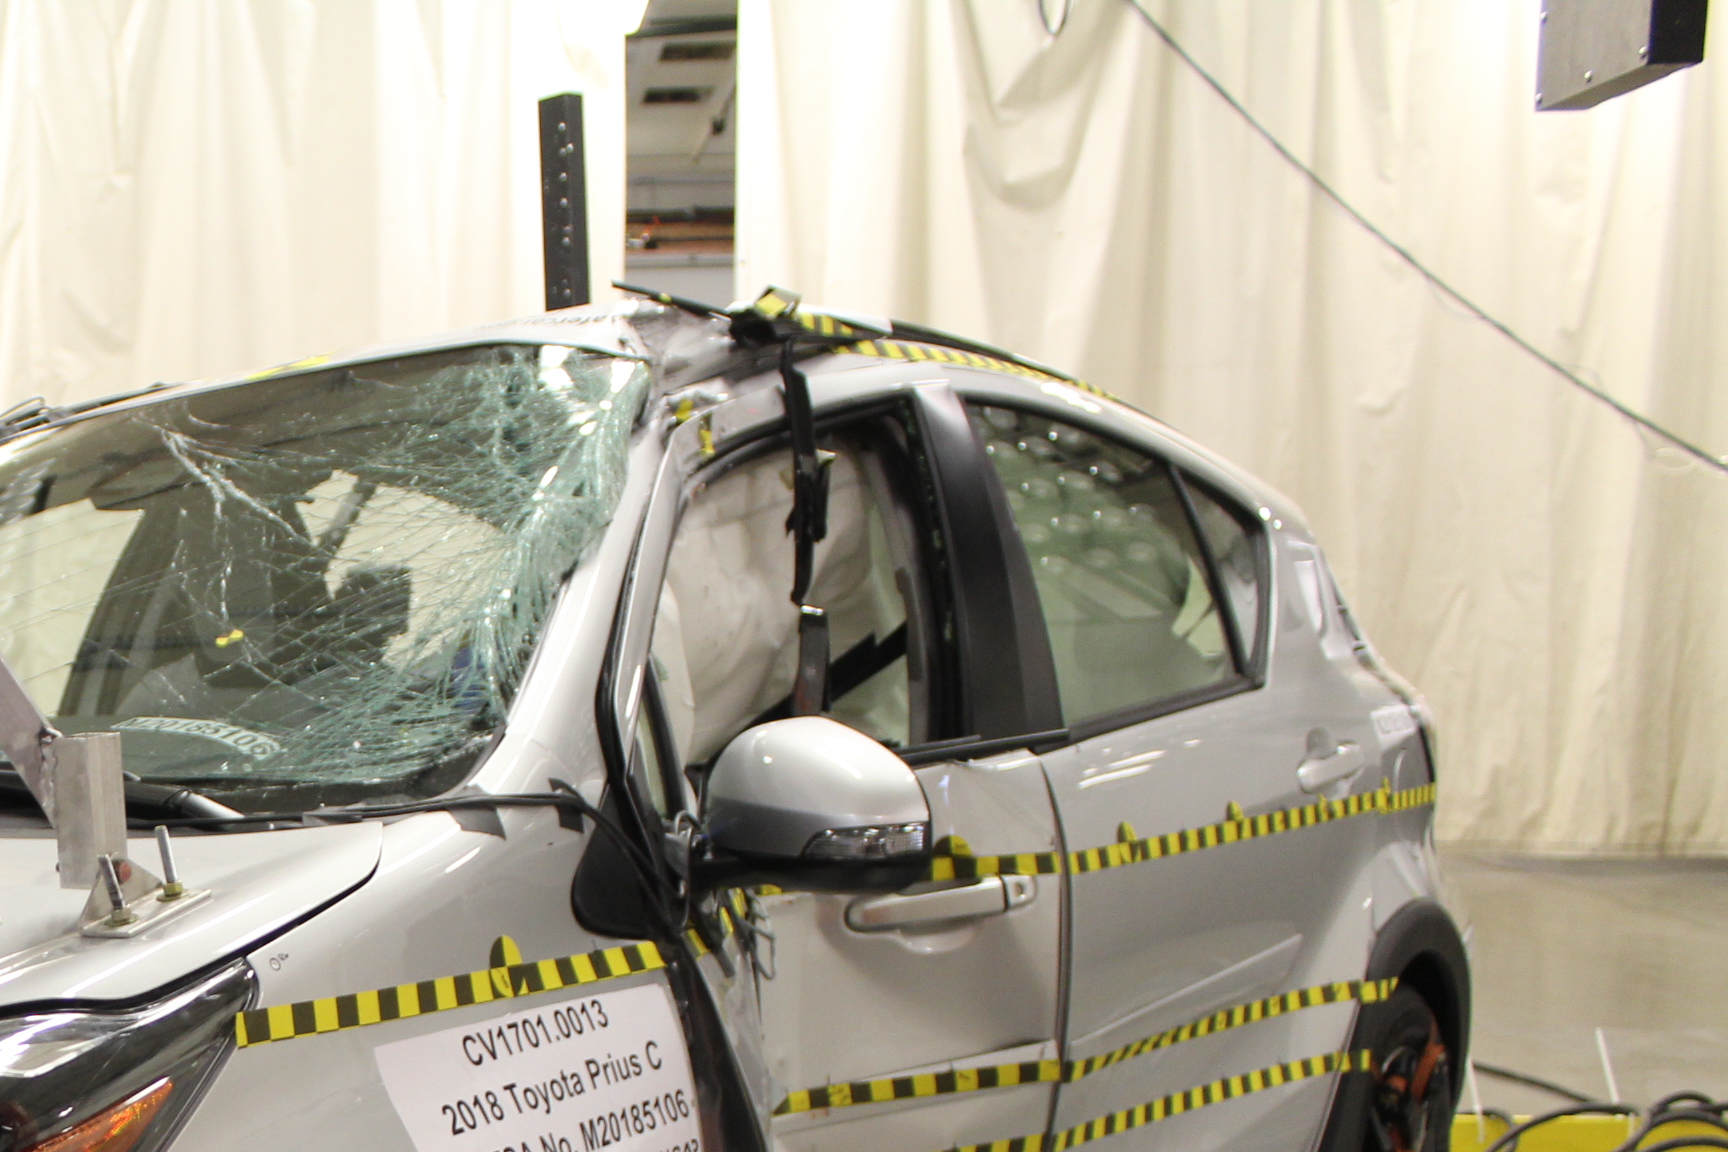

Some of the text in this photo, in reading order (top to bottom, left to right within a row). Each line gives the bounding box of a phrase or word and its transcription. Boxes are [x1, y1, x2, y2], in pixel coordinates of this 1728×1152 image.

[124, 718, 273, 756] M20185106
[462, 1000, 608, 1066] CV1701.0013
[442, 1041, 661, 1135] 2018 Toyota Prius C
[580, 1089, 689, 1151] M20185106
